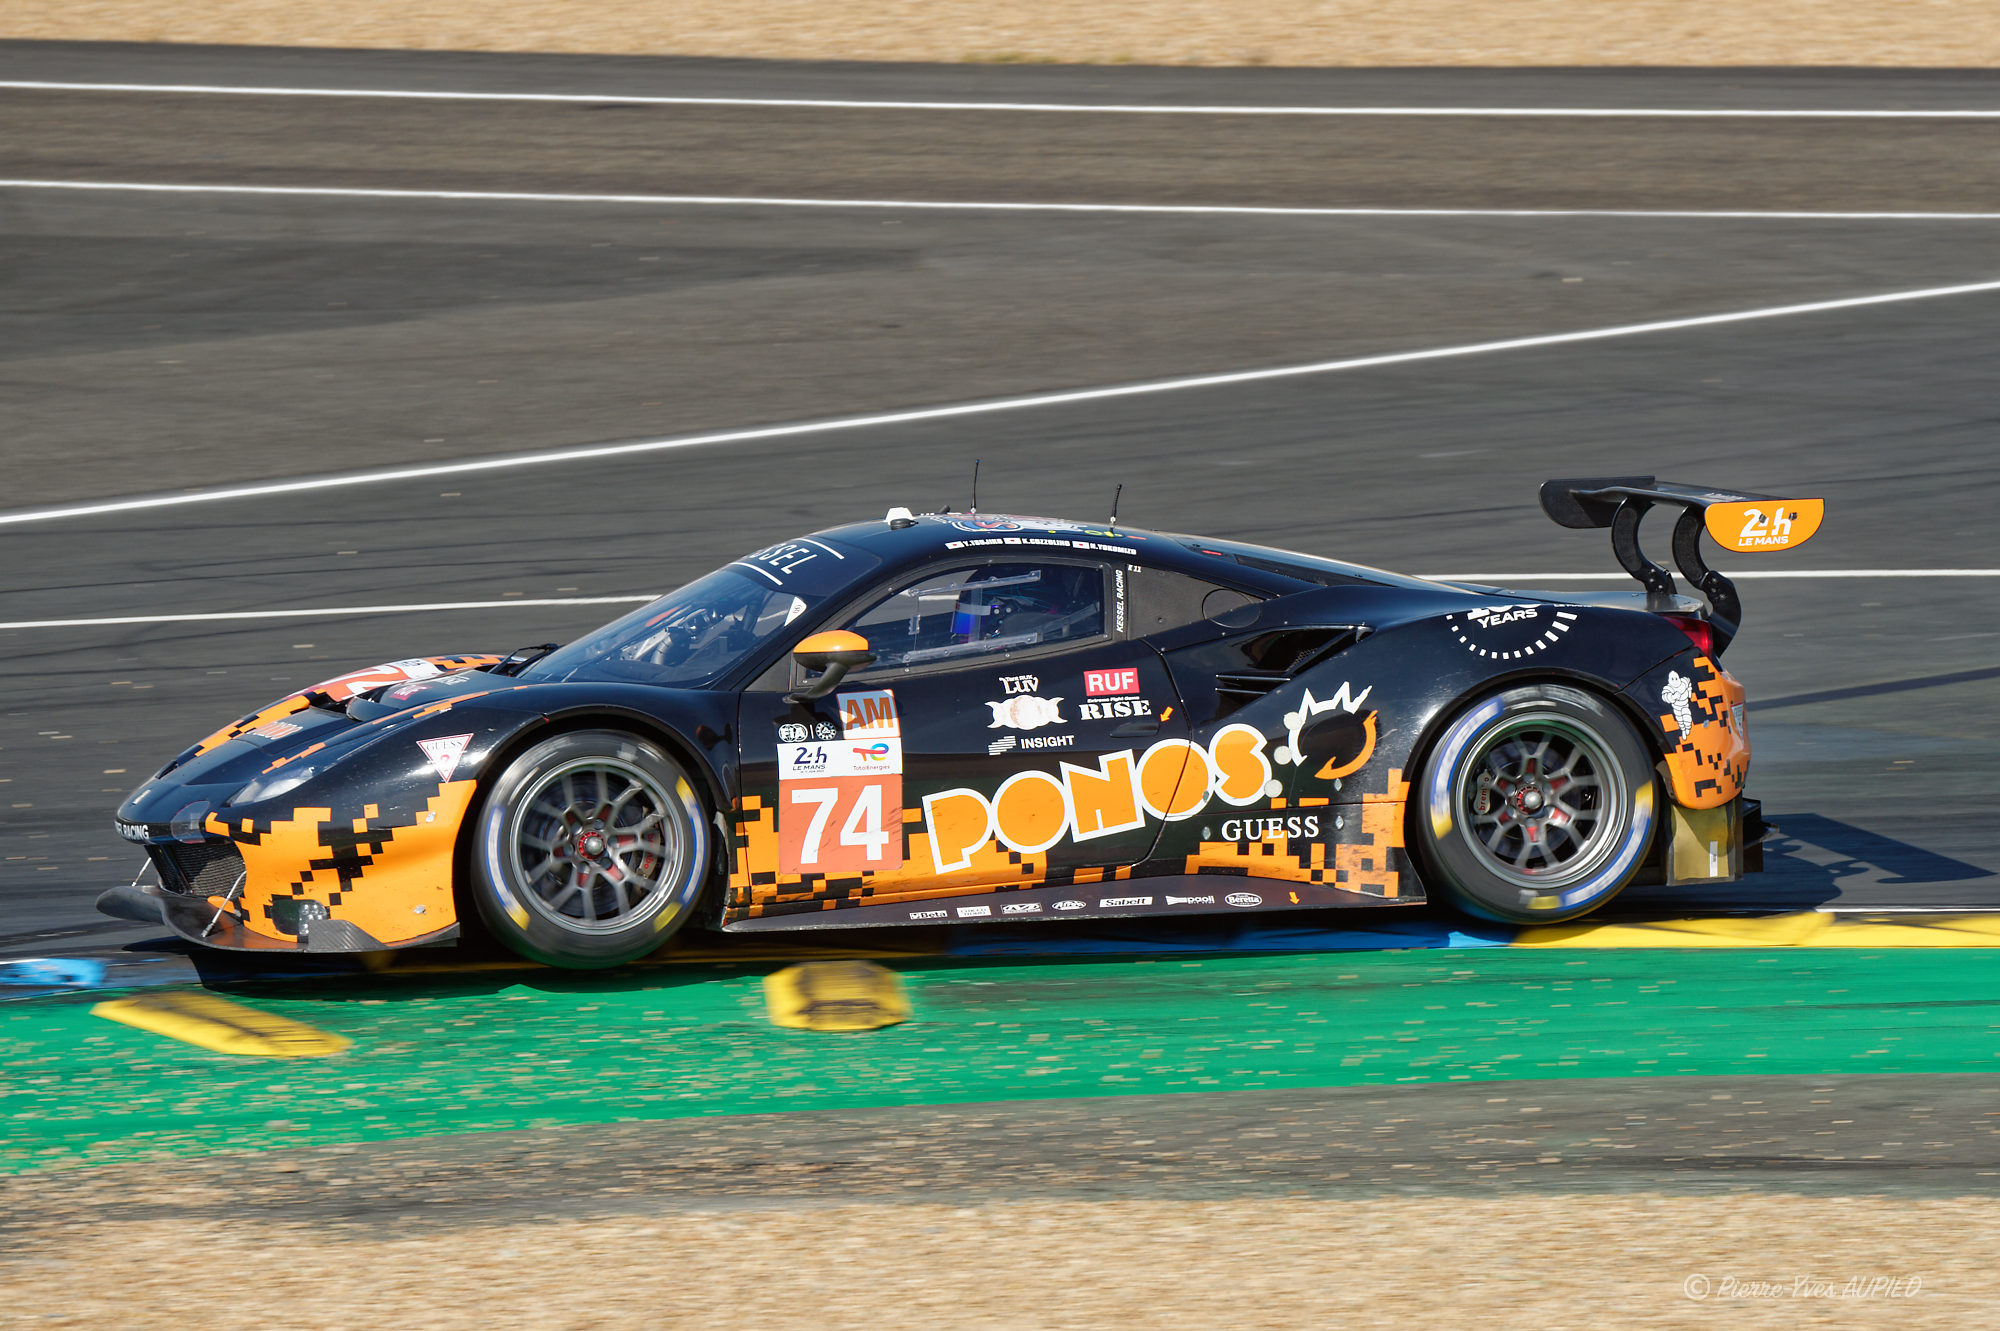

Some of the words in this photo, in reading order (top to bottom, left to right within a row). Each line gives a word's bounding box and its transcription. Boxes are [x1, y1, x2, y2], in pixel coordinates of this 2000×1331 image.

[1738, 537, 1754, 546] LE
[1754, 535, 1789, 545] MANS
[1115, 569, 1124, 600] RACING
[1116, 601, 1124, 633] KESSEL
[1477, 608, 1538, 629] YEARS
[1087, 671, 1134, 693] RUF
[844, 697, 894, 731] AM
[1078, 700, 1152, 720] RISE
[426, 741, 464, 751] GUESS
[1020, 735, 1075, 749] INSIGHT
[921, 723, 1273, 875] PONOS
[1478, 777, 1490, 812] bremo
[120, 822, 150, 841] RACING
[791, 784, 889, 865] 74
[1221, 816, 1319, 841] GUESS
[1105, 898, 1147, 907] Sabelt
